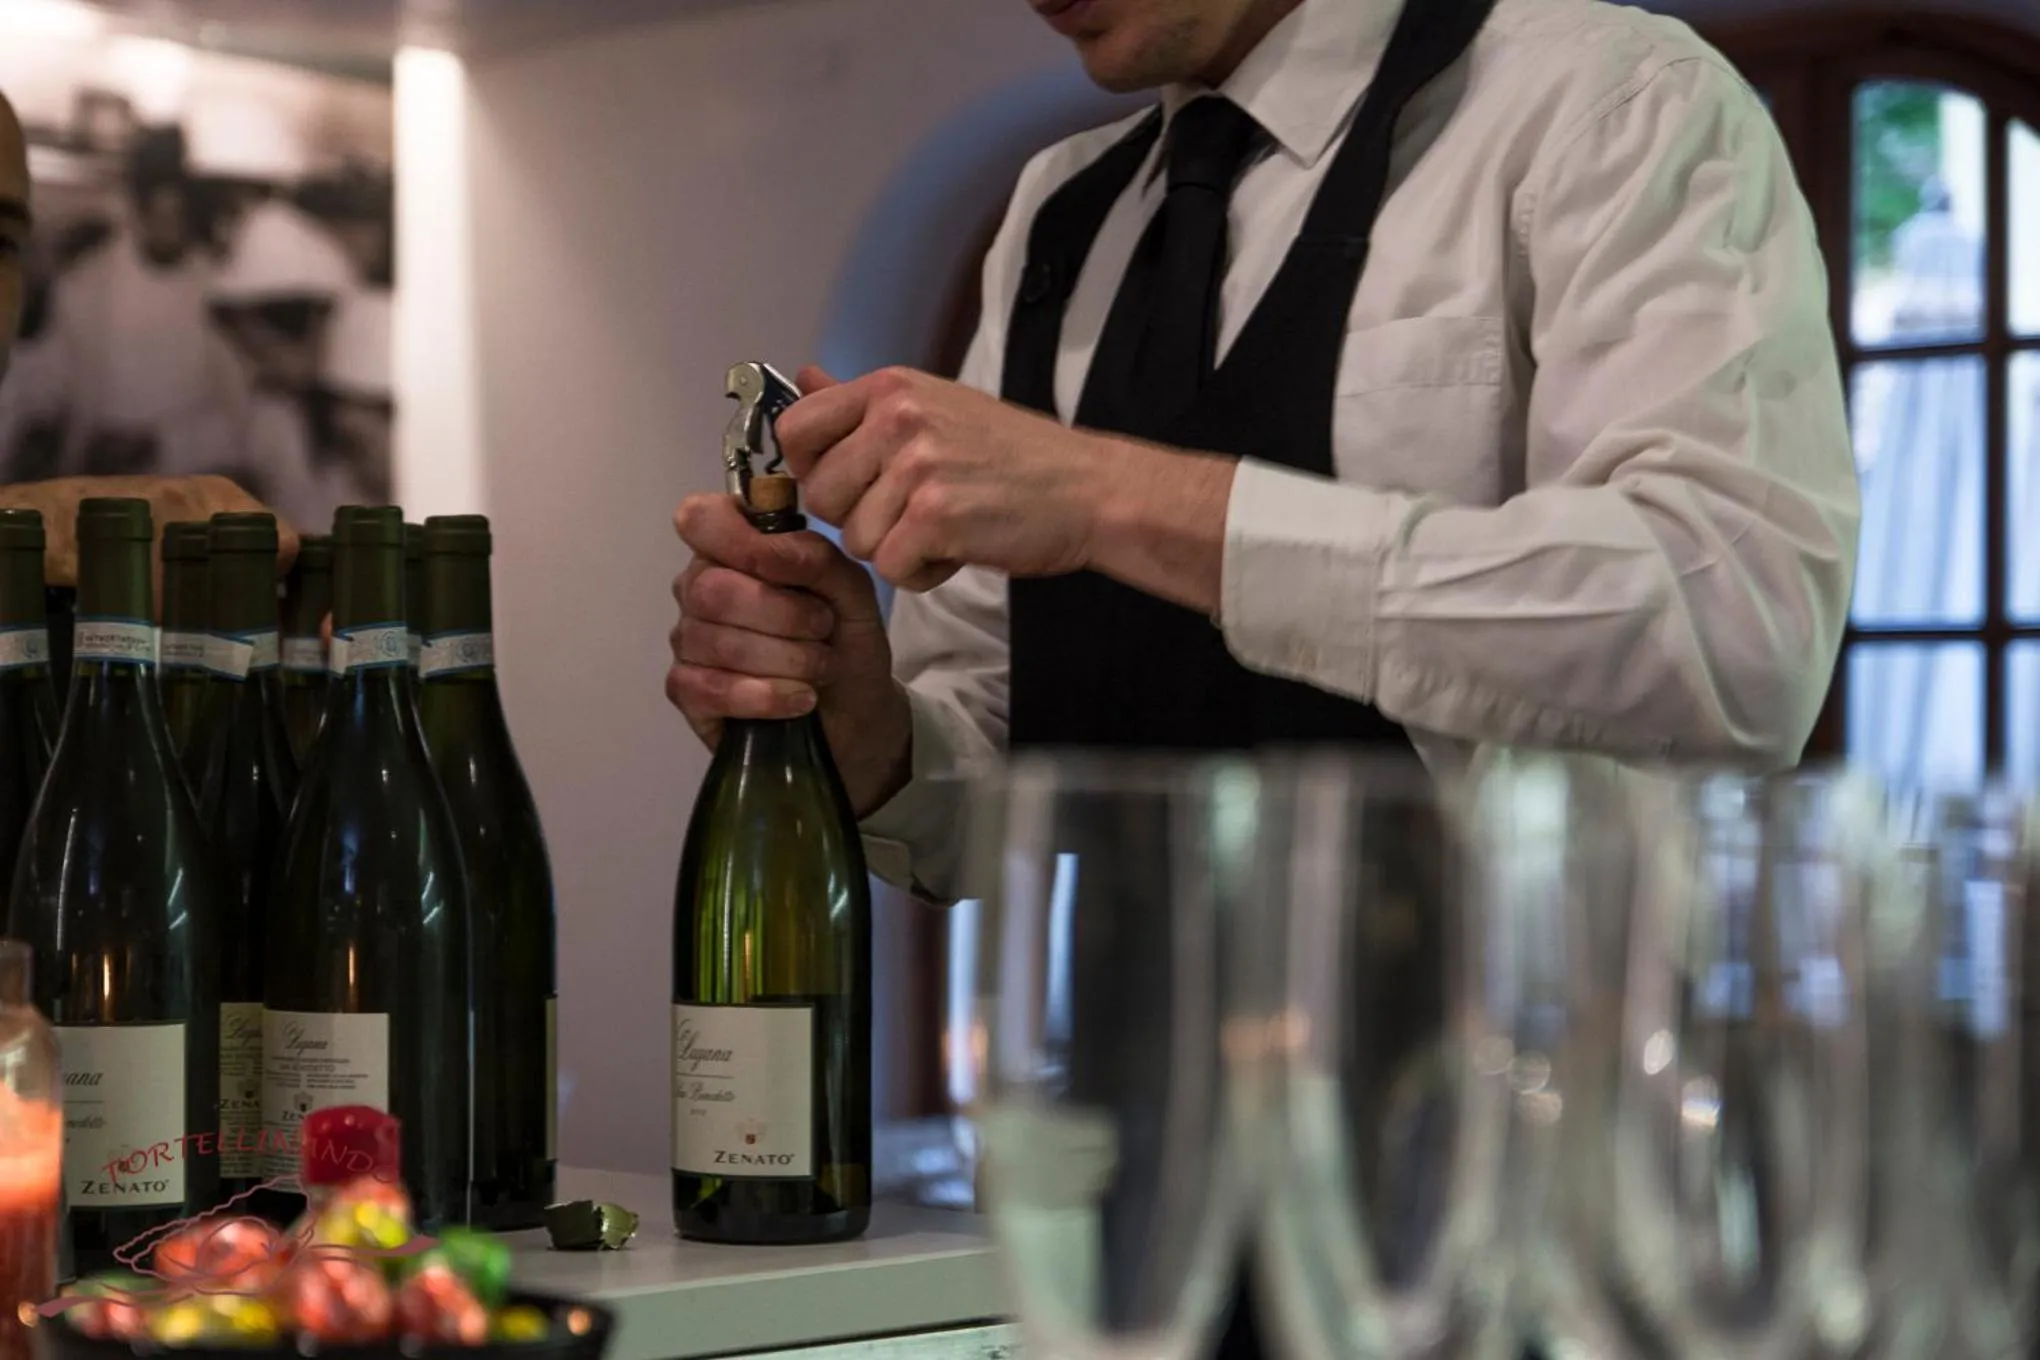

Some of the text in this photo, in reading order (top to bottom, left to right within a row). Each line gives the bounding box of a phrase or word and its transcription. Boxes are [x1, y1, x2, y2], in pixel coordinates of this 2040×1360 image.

[64, 1071, 103, 1086] ana
[221, 1099, 260, 1110] ZENA
[282, 1110, 304, 1122] ZEN
